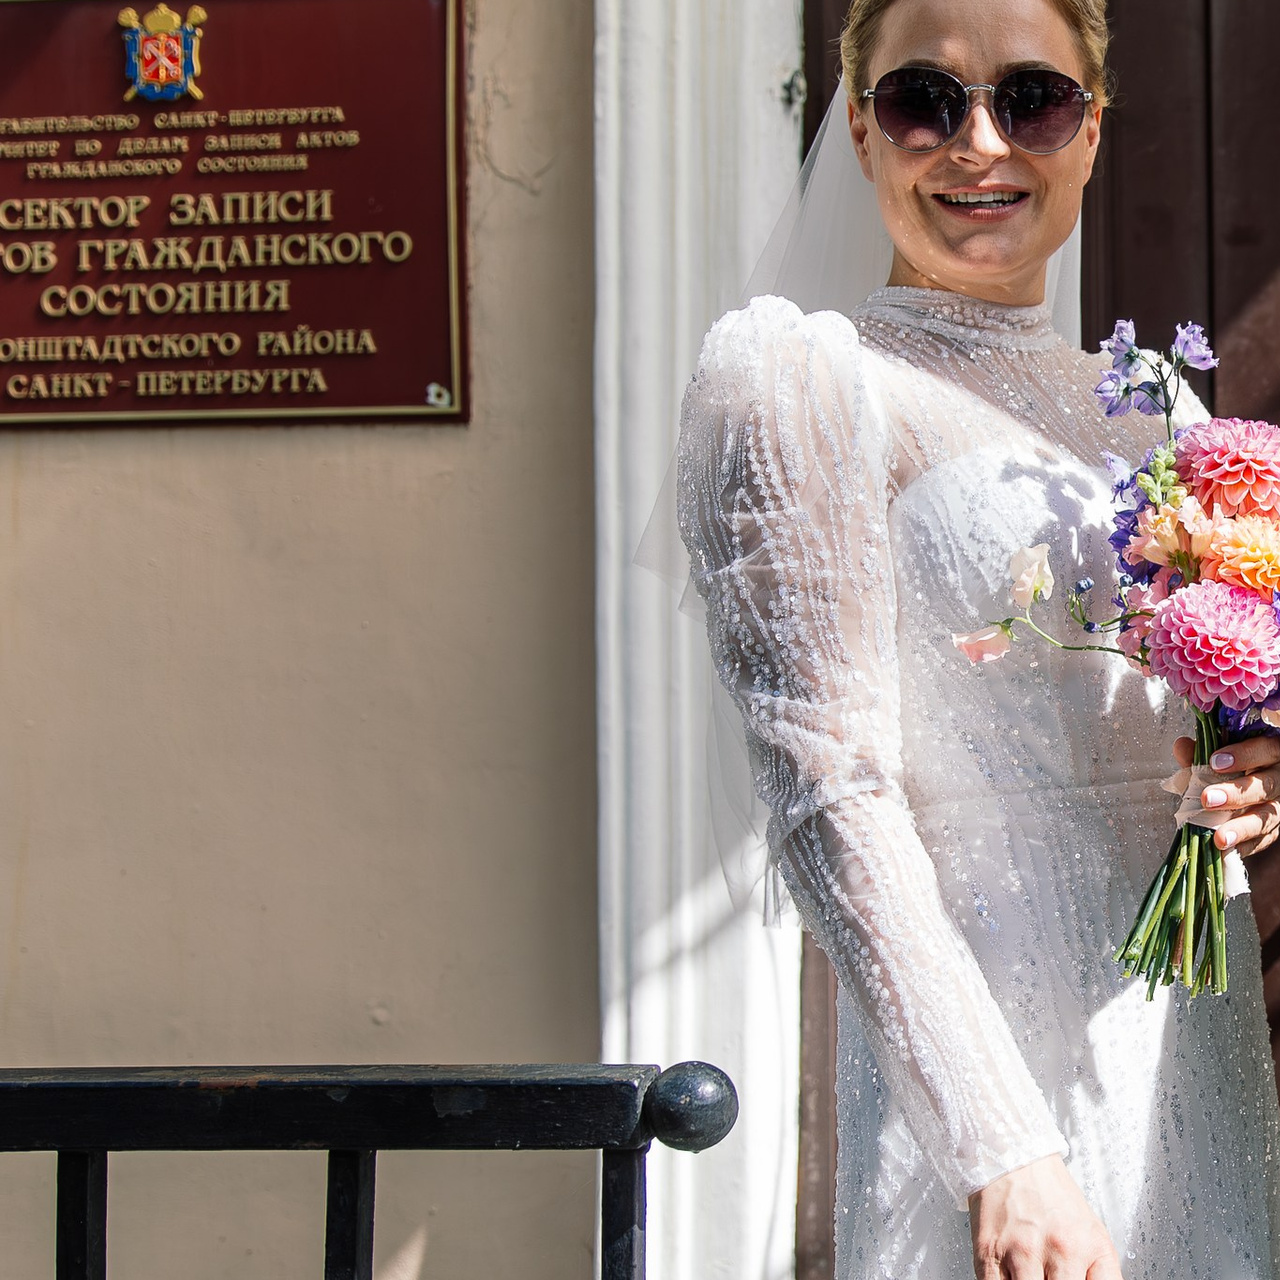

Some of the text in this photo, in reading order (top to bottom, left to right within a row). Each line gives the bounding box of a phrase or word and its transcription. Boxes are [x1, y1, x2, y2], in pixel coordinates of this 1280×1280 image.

[75, 138, 102, 156] ПО
[117, 135, 190, 156] ДЕЛАМ
[204, 132, 282, 151] ЗАПИСИ
[296, 130, 360, 149] АКТОВ
[27, 154, 309, 179] ГРАЖДАНСКОГО СОСТОЯНИЯ
[0, 189, 334, 230] СЕКТОР ЗАПИСИ
[0, 230, 413, 274] ОВ ГРАЖДАНСКОГО
[40, 279, 291, 317] СОСТОЯНИЯ
[257, 324, 377, 356] РАЙОНА
